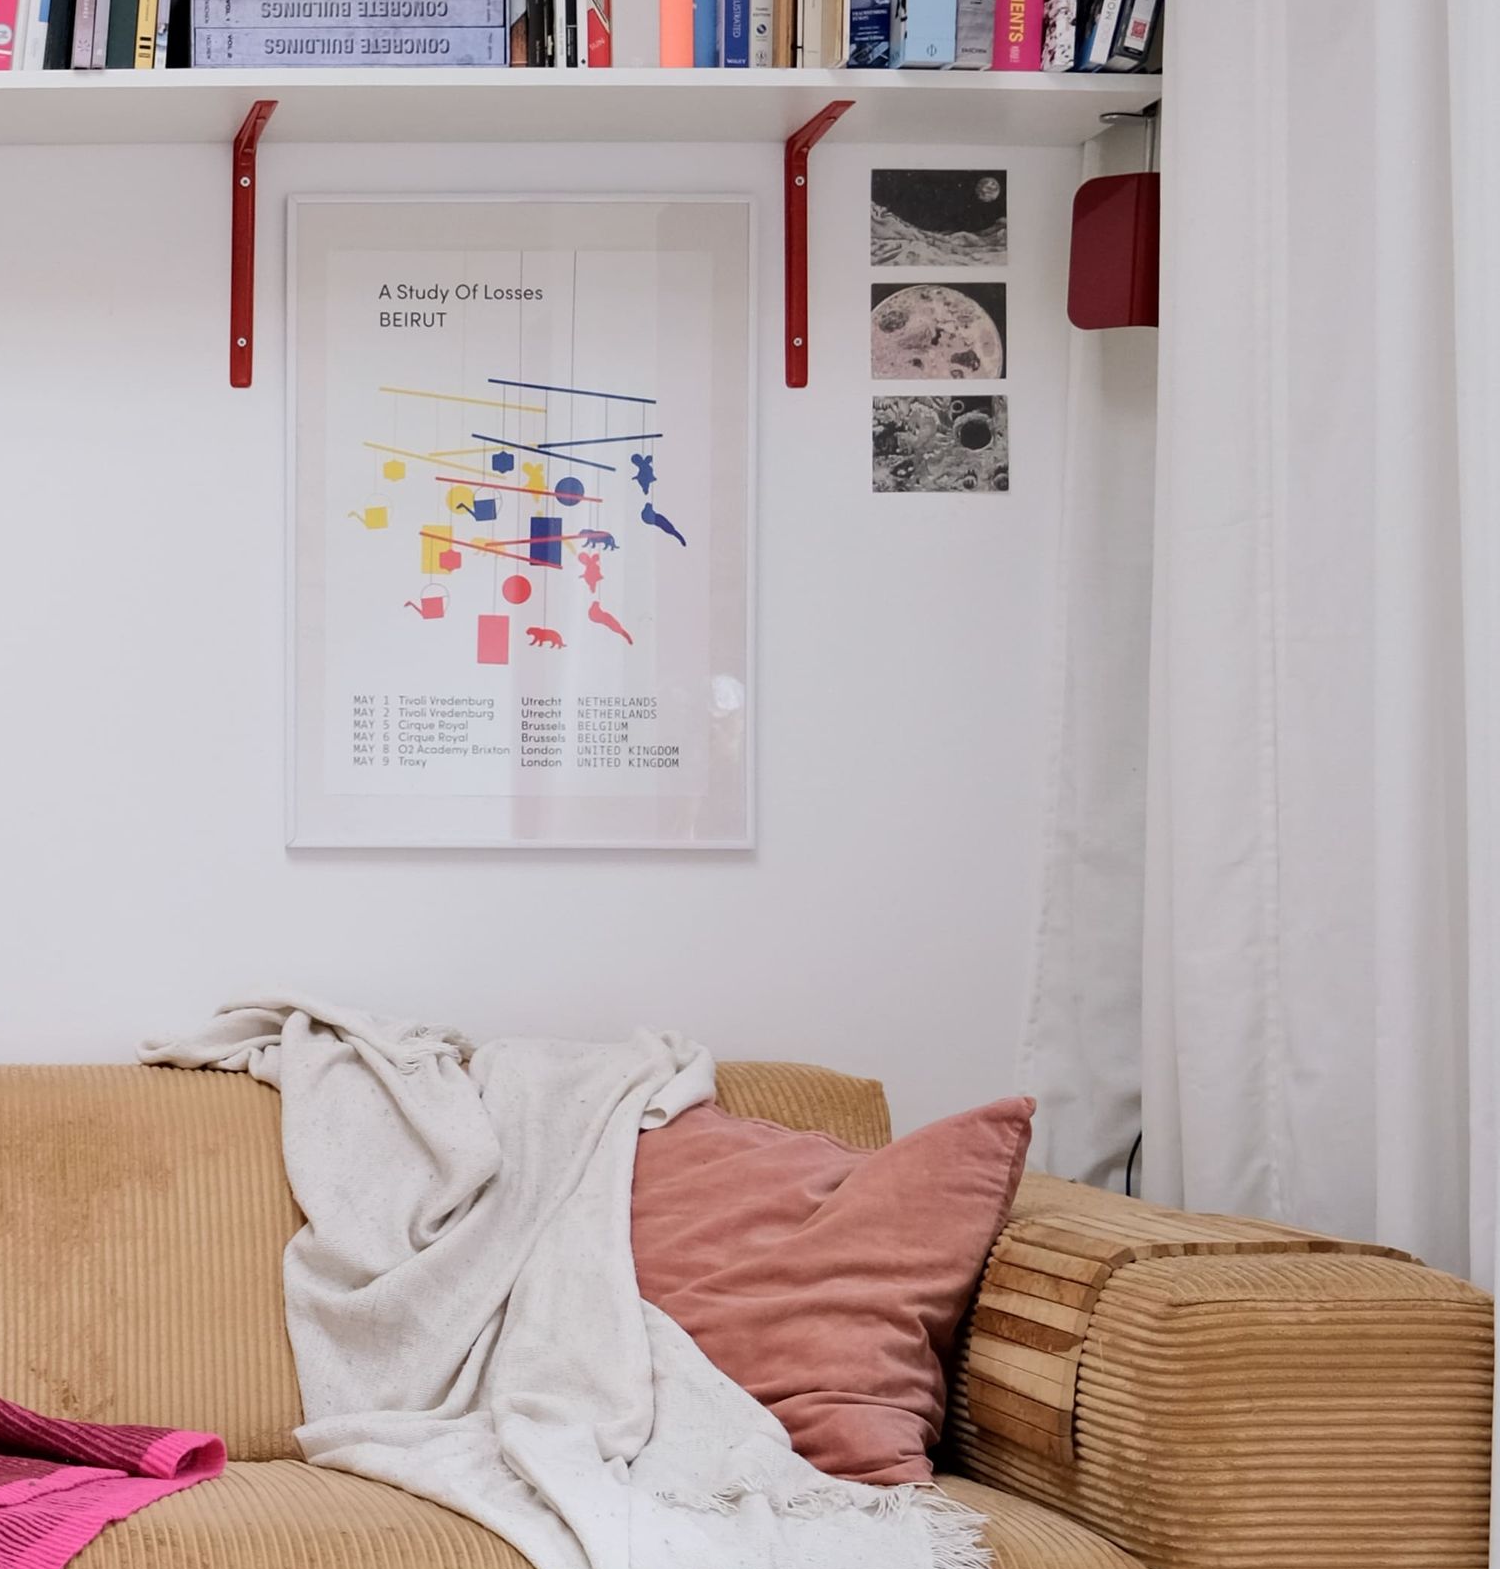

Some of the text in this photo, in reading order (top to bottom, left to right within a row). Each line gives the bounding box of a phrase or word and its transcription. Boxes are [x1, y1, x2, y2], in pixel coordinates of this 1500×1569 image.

[260, 1, 449, 18] CONCRETE BUILDINGS
[264, 38, 450, 55] CONCRETE BUILDINGS
[379, 284, 543, 304] A Study Of Losses
[380, 312, 447, 327] BEIRUT
[354, 695, 374, 704] MAY
[399, 695, 426, 705] Tivoli
[430, 696, 494, 708] Vredenburg
[522, 697, 561, 706] Utrecht
[578, 697, 657, 707] NETHERLANDS
[354, 708, 374, 717] MAY
[398, 708, 426, 717] Tivoli
[429, 707, 494, 720] Vredenburg
[521, 709, 561, 718] Utrecht
[578, 709, 657, 719] NETHERLANDS
[354, 720, 374, 729] MAY
[398, 720, 435, 731] Cirque
[439, 720, 468, 732] Royal
[521, 721, 565, 730] Brussels
[578, 721, 628, 731] BELGIUM
[354, 732, 375, 741] MAY
[398, 732, 435, 743] Cirque
[439, 731, 468, 744] Royal
[522, 733, 565, 742] Brussels
[578, 733, 628, 743] BELGIUM
[353, 744, 374, 754] MAY
[417, 743, 468, 756] Academy
[472, 745, 510, 755] Brixton
[521, 745, 561, 755] London
[577, 745, 621, 755] UNITED
[629, 746, 679, 755] KINGDOM
[353, 756, 374, 765] MAY
[521, 758, 561, 767] London
[577, 758, 621, 767] UNITED
[629, 758, 679, 768] KINGDOM
